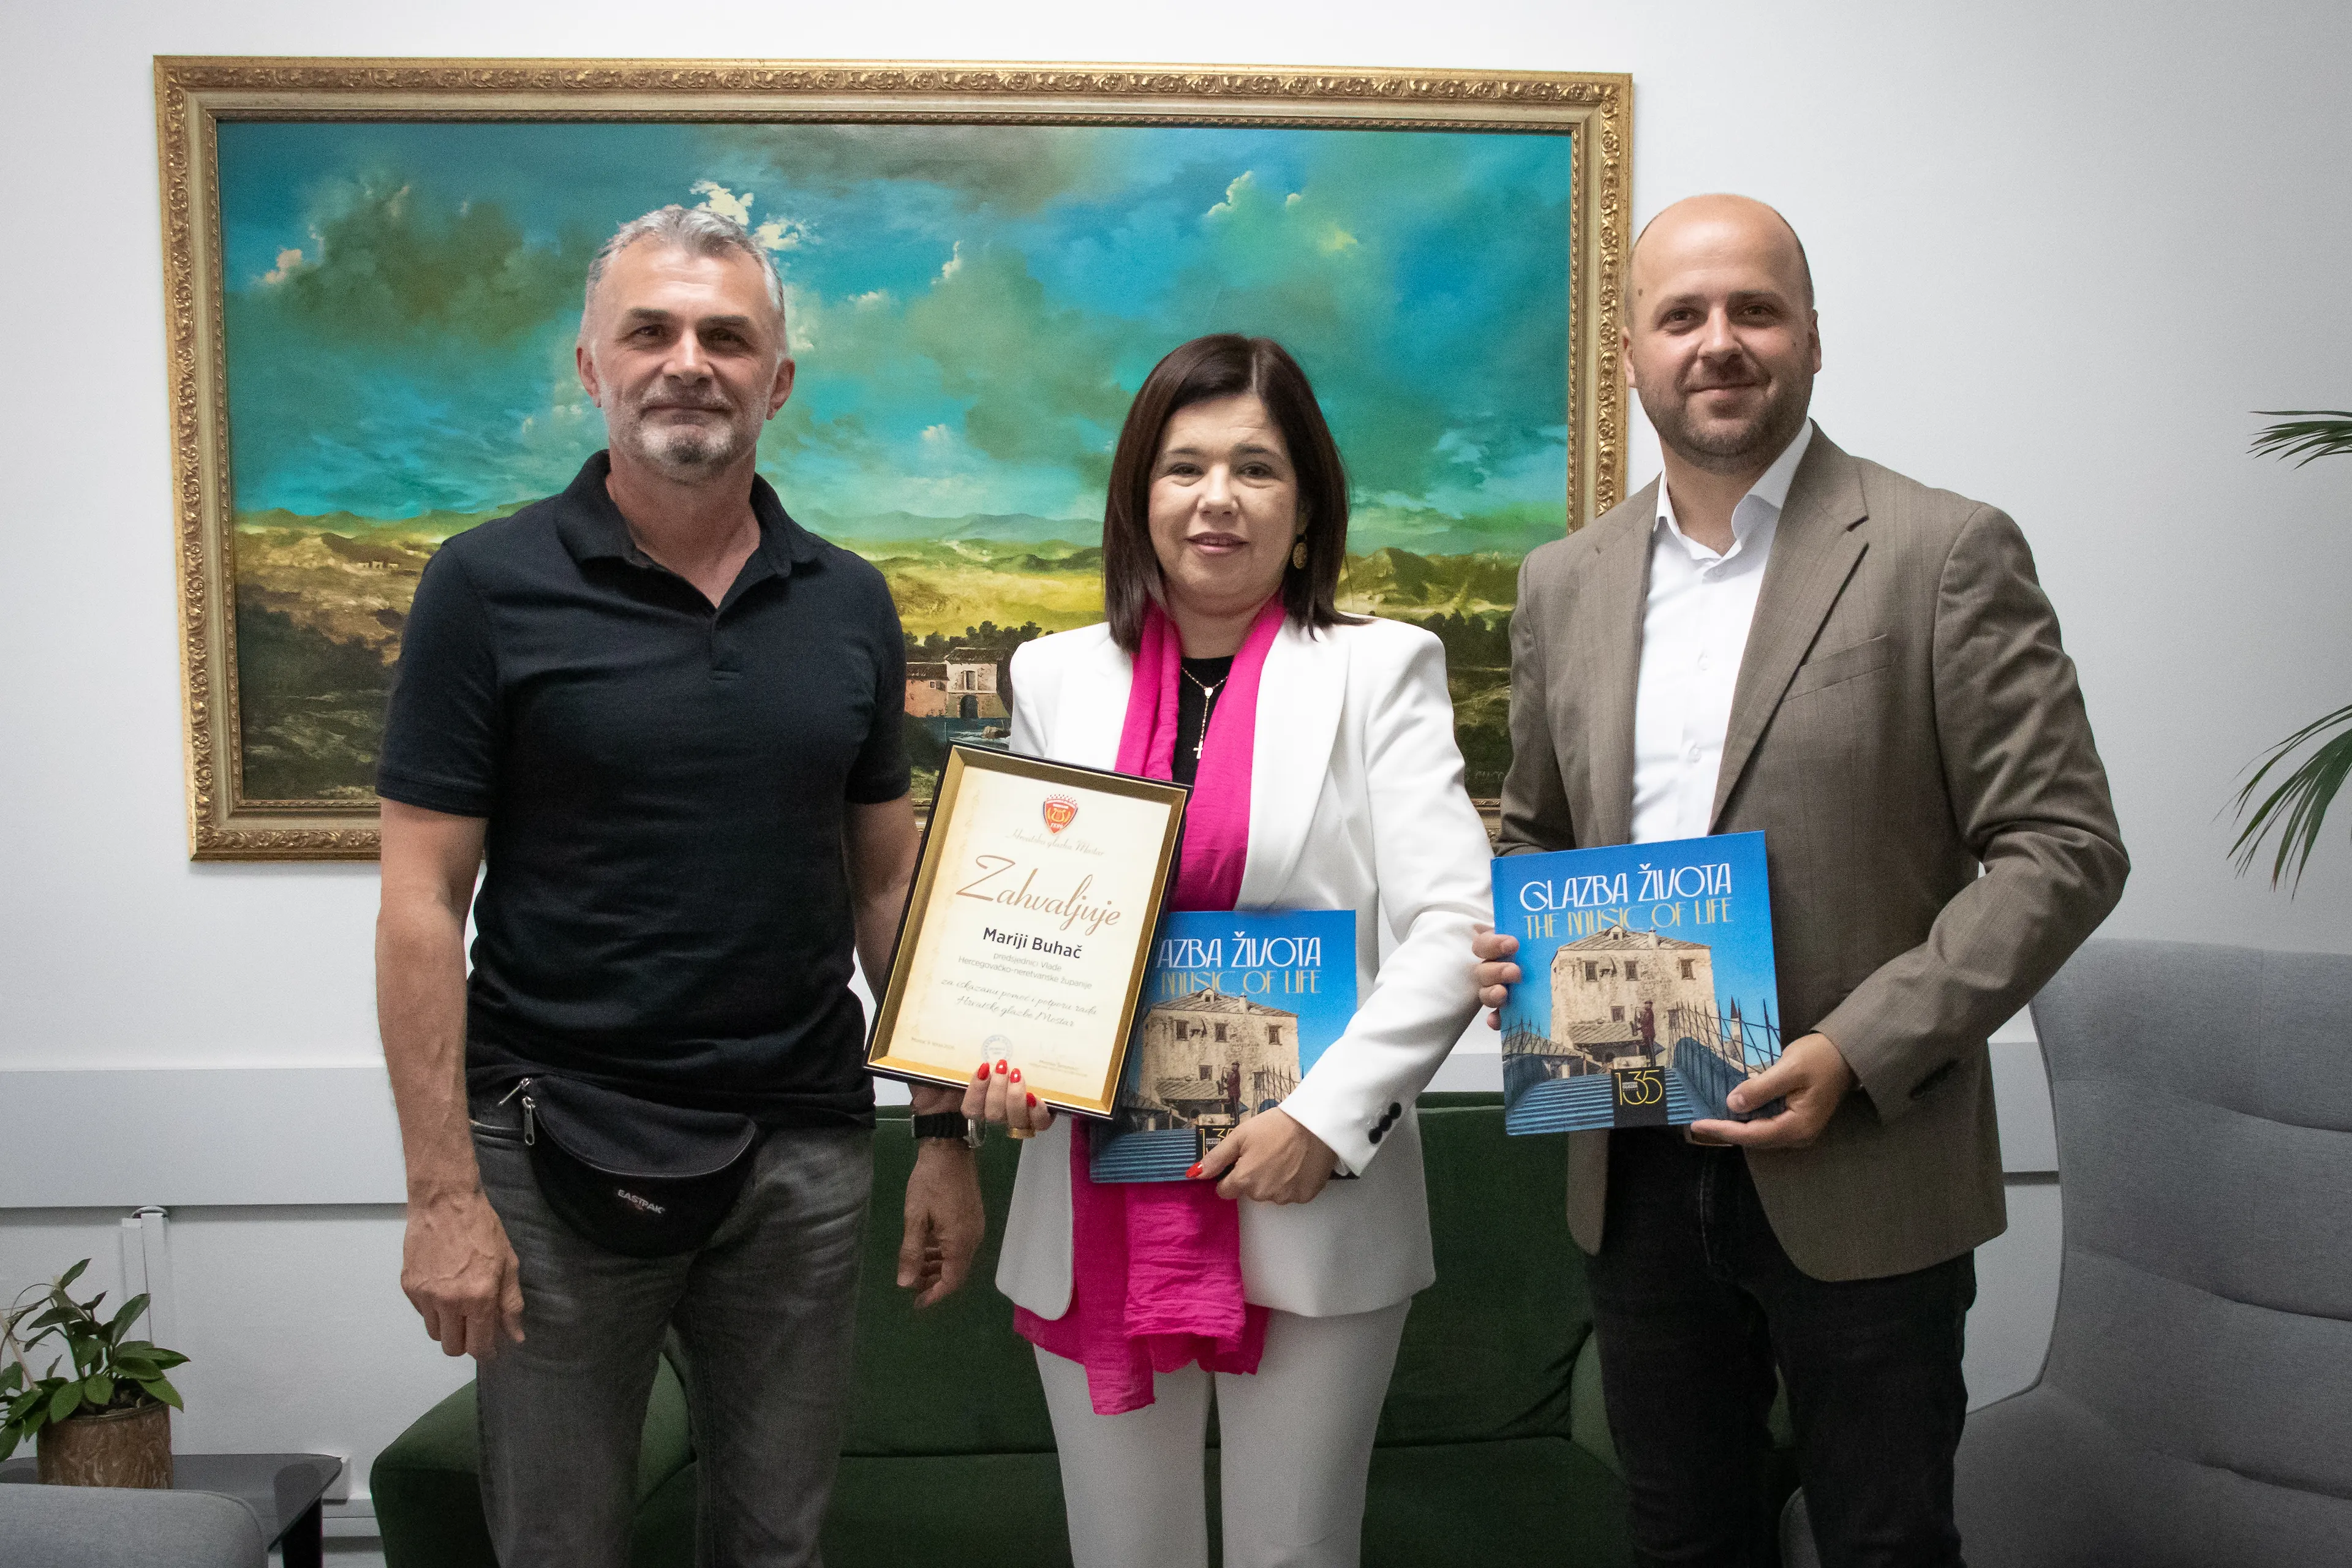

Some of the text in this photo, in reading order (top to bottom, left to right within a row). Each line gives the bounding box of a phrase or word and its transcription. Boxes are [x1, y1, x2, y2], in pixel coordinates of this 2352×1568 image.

[956, 854, 1121, 936] Zahvaljuje
[1520, 862, 1732, 911] GLAZBA ŽIVOTA
[1523, 897, 1734, 939] THE MUSIC OF LIFE
[983, 927, 1082, 959] Mariji Buhač
[1156, 931, 1321, 968] AZBA ŽIVOTA
[993, 952, 1061, 972] predsjednici Vlade
[1060, 976, 1092, 990] županije
[1243, 970, 1277, 995] OF
[1285, 970, 1322, 993] LIFE
[1615, 1069, 1663, 1106] 135
[617, 1189, 666, 1214] EASTPAK
